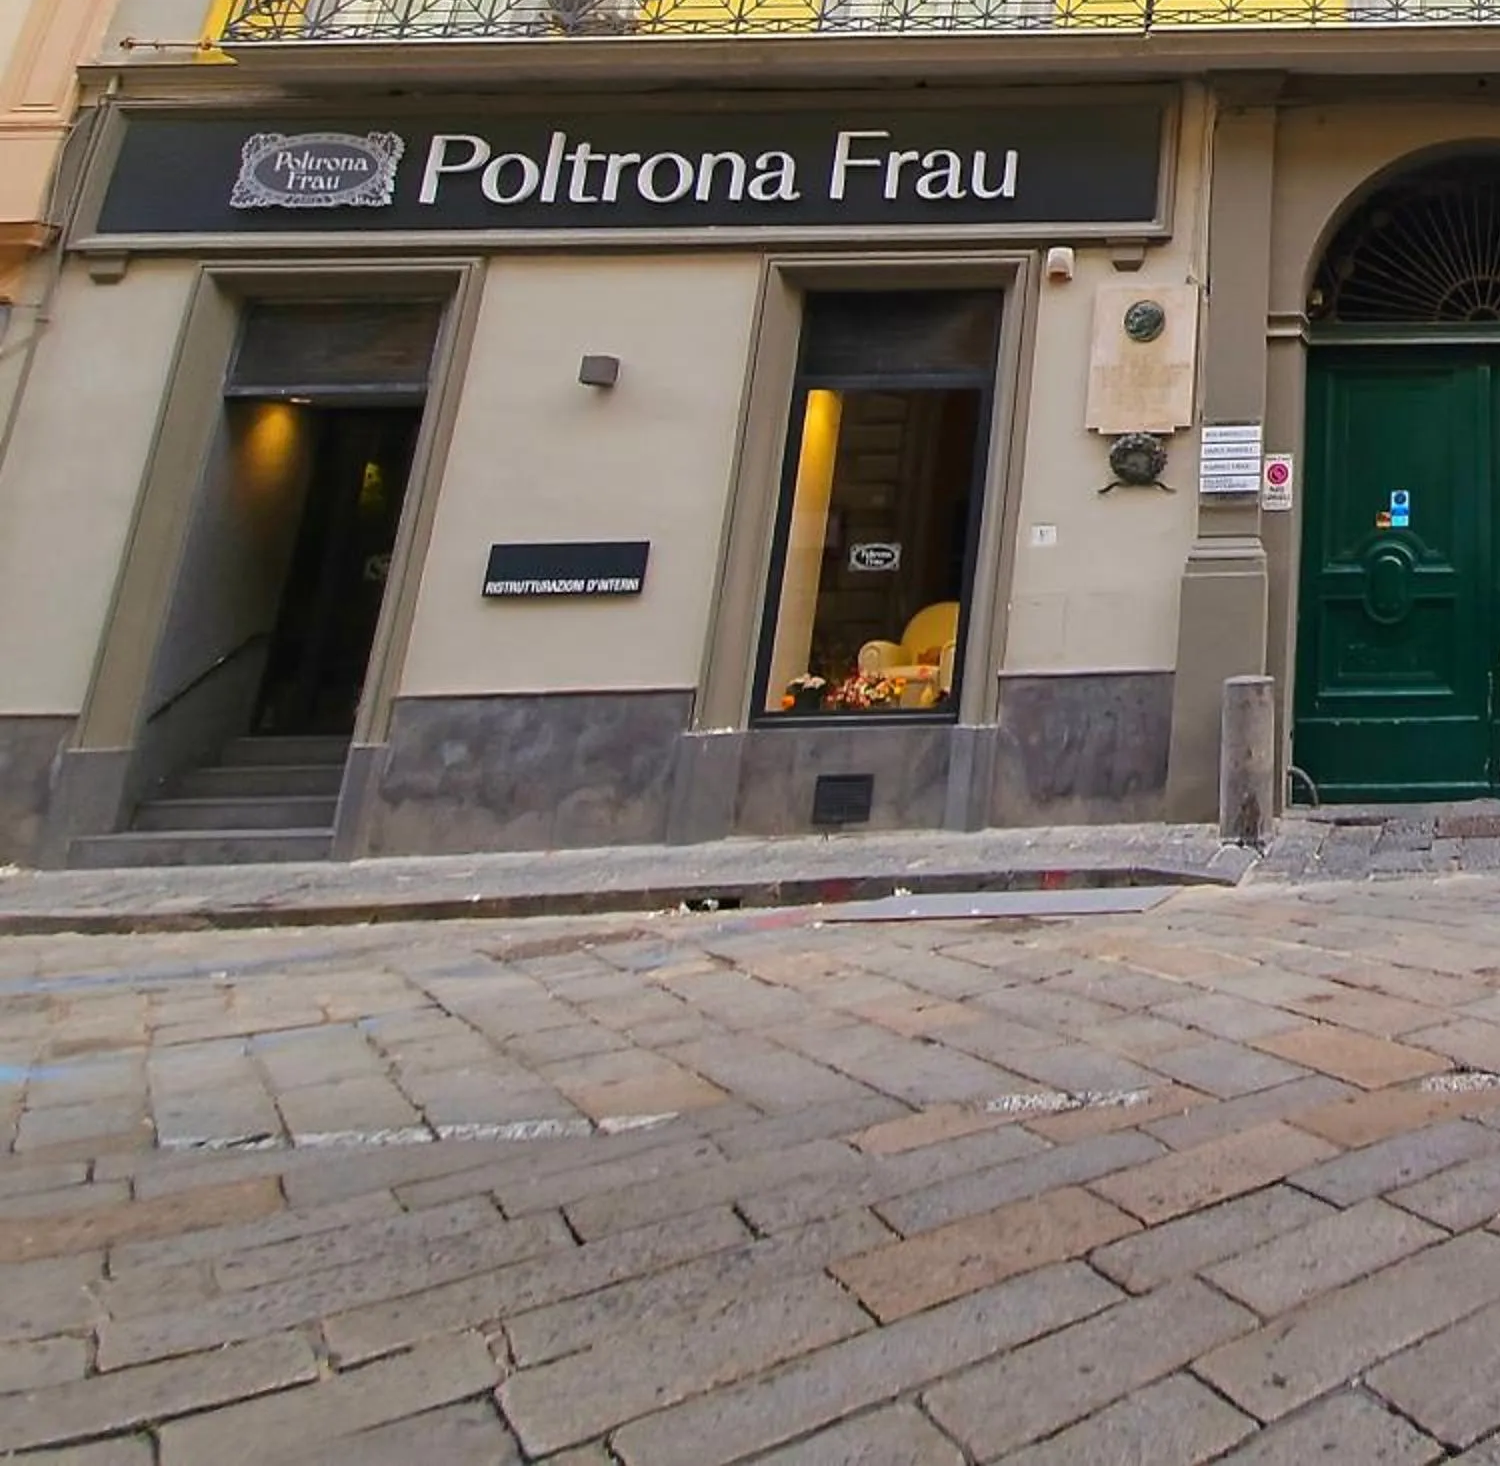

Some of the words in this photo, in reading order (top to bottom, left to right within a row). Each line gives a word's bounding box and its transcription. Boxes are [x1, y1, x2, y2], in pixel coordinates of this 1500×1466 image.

[274, 150, 368, 172] Poltrona
[419, 131, 800, 204] Poltrona
[829, 131, 1018, 201] Frau
[287, 171, 341, 191] Frau
[485, 579, 585, 595] RISTRUTTURAZIONI
